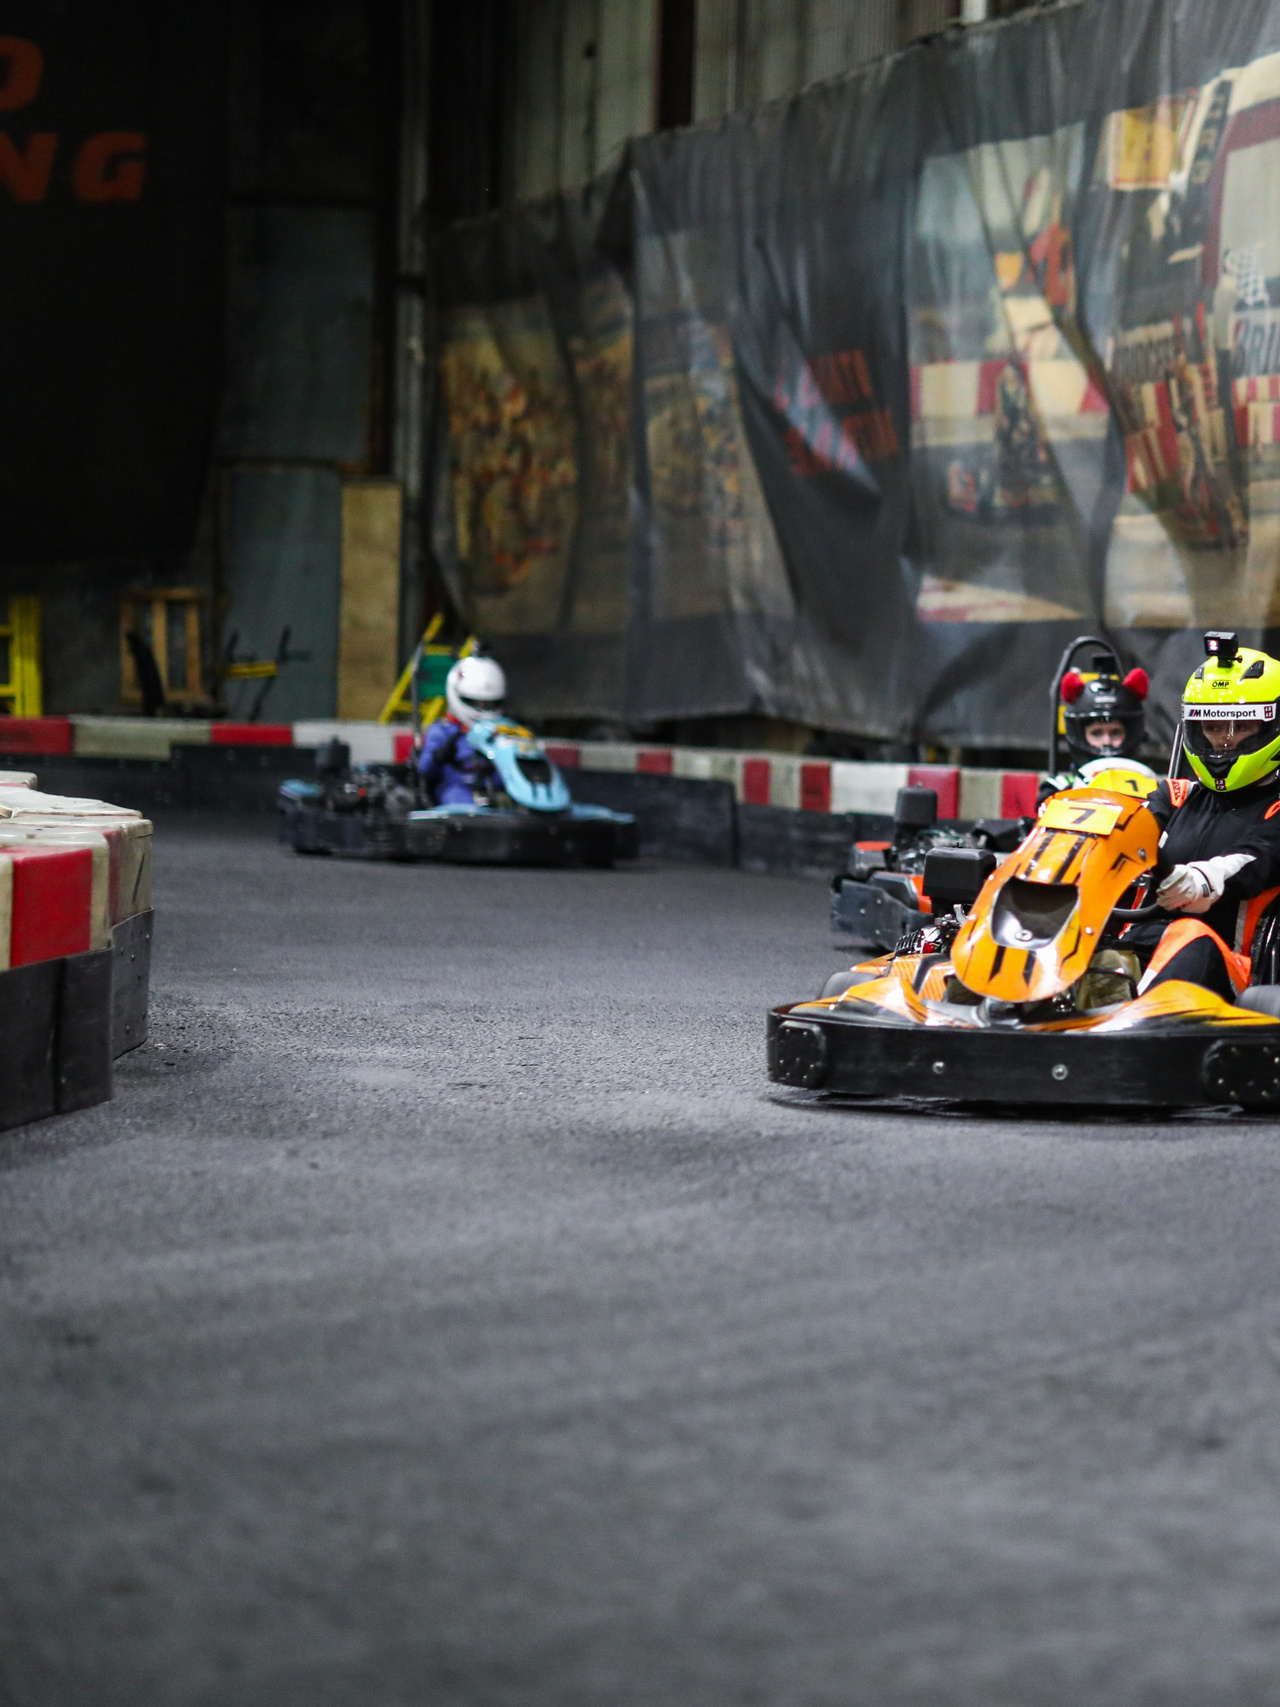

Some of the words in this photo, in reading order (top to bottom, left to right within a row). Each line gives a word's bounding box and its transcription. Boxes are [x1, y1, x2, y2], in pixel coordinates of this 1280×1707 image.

[1202, 709, 1257, 719] Motorsport
[1125, 779, 1139, 792] 1
[1068, 806, 1097, 824] 7
